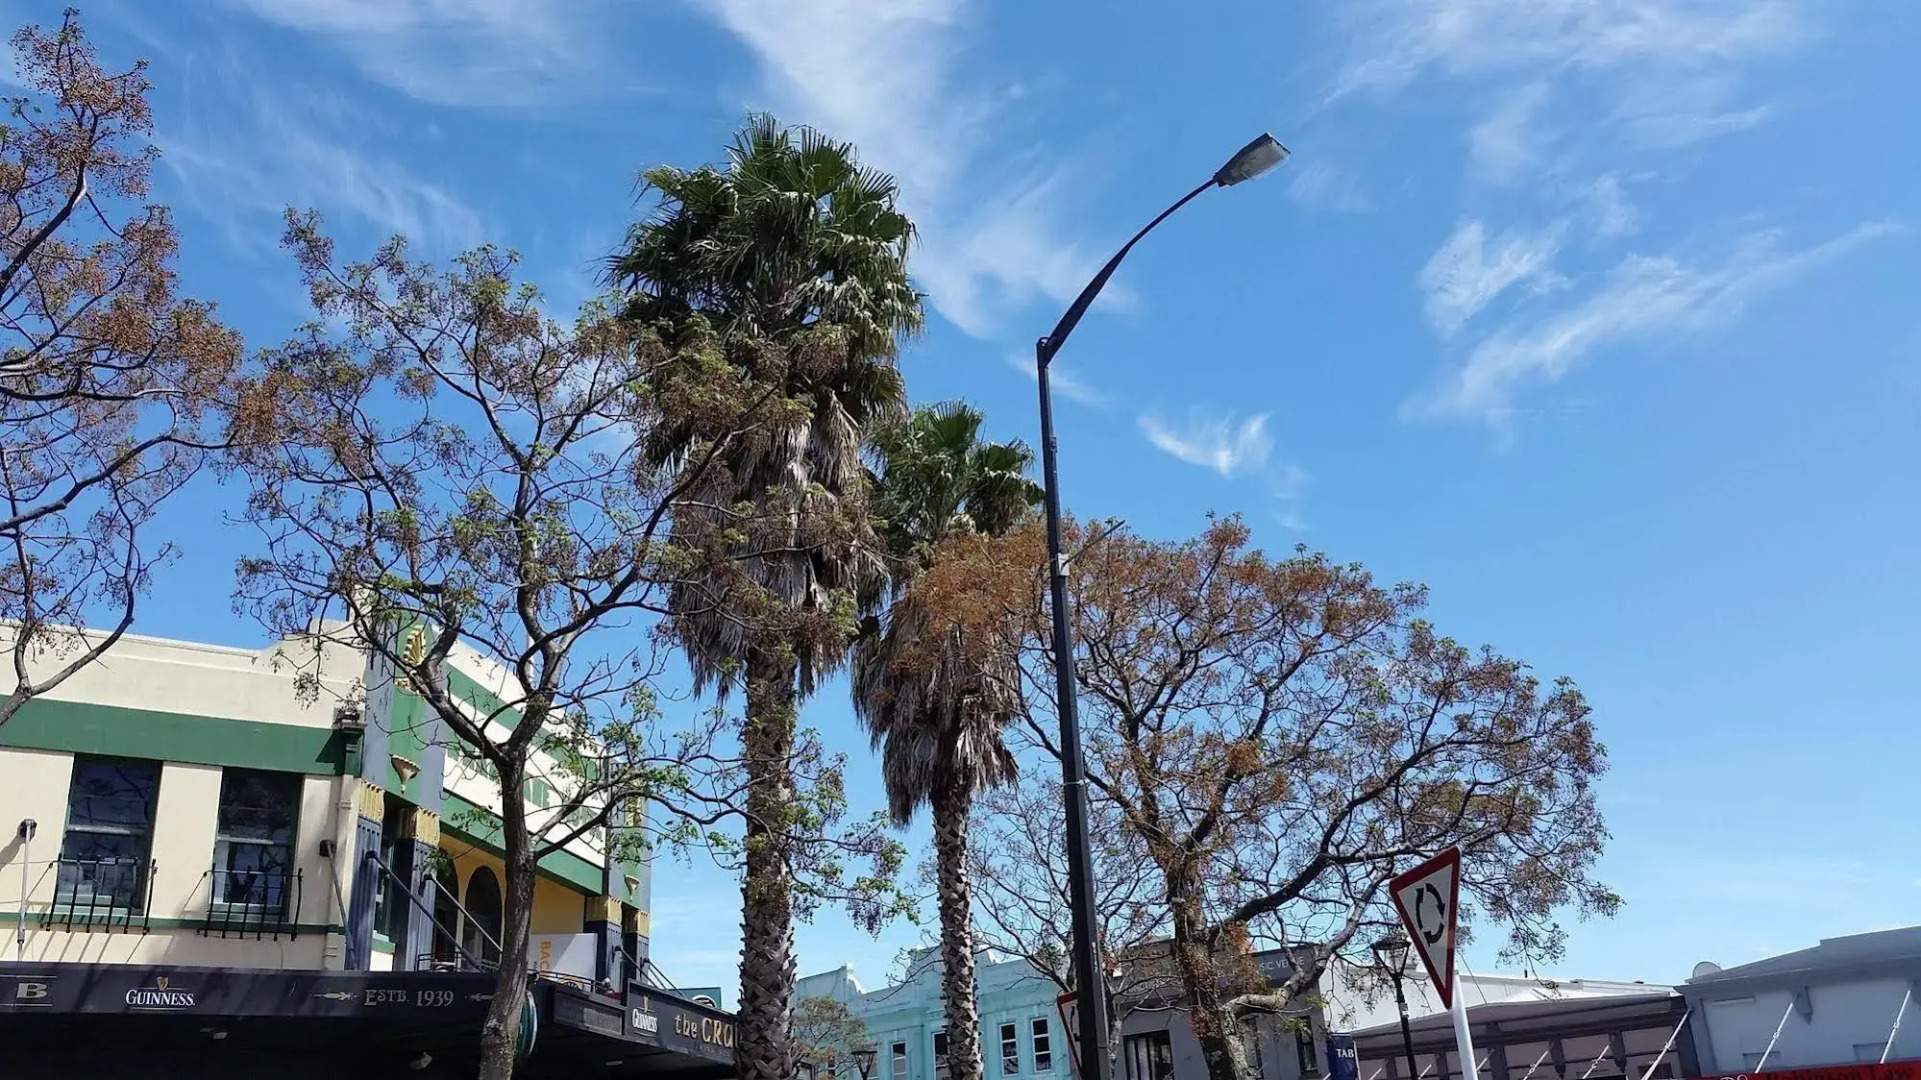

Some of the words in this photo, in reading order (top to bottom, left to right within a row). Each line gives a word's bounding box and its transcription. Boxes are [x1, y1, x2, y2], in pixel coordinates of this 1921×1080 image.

[16, 982, 48, 999] B
[416, 990, 454, 1007] 1939
[674, 1013, 698, 1039] the
[1335, 1048, 1354, 1058] TAB
